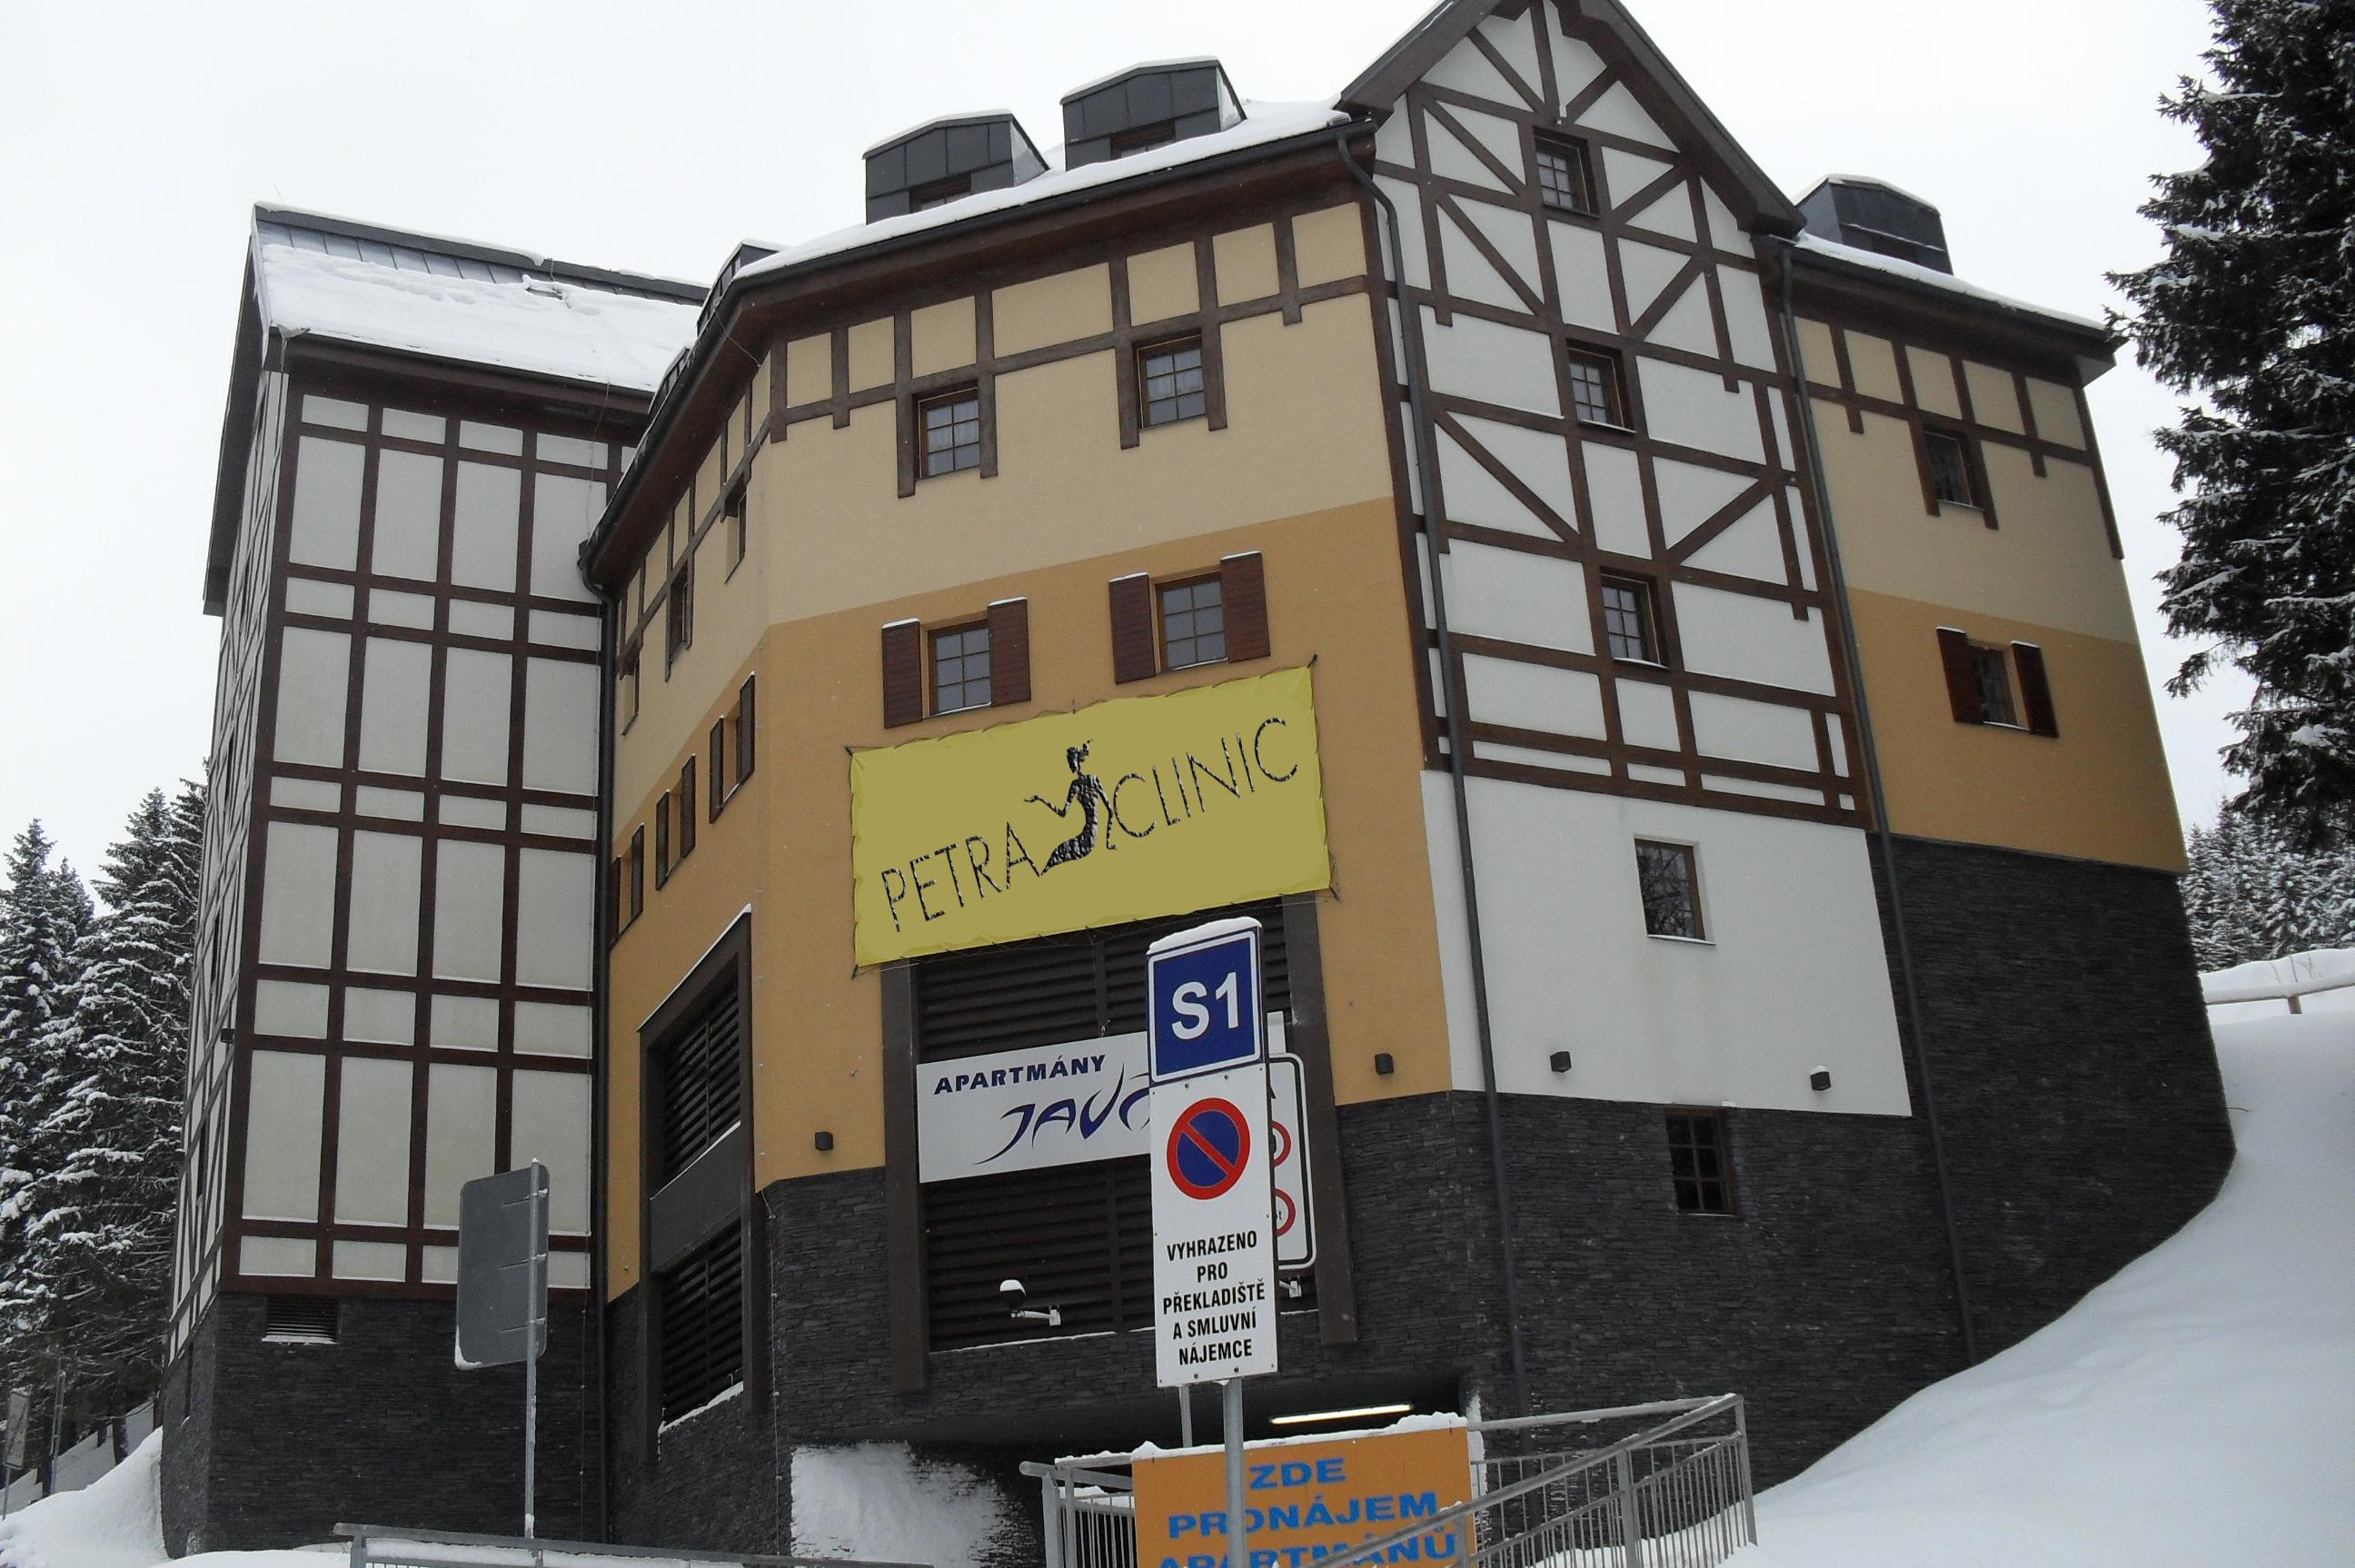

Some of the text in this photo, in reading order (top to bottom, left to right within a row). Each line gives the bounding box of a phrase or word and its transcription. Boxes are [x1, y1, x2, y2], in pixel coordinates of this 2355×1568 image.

[881, 716, 1298, 933] PETRA CLINIC
[1170, 972, 1240, 1040] S1
[933, 1054, 1106, 1095] APARTMÁNY
[1167, 1229, 1257, 1261] VYHRAZENO
[1197, 1262, 1227, 1283] PRO
[1163, 1277, 1266, 1315] PŘEKLADIŠTĚ
[1173, 1305, 1257, 1340] A SMLUVNÍ
[1178, 1338, 1252, 1365] NÁJEMCE
[1249, 1457, 1346, 1490] ZDE
